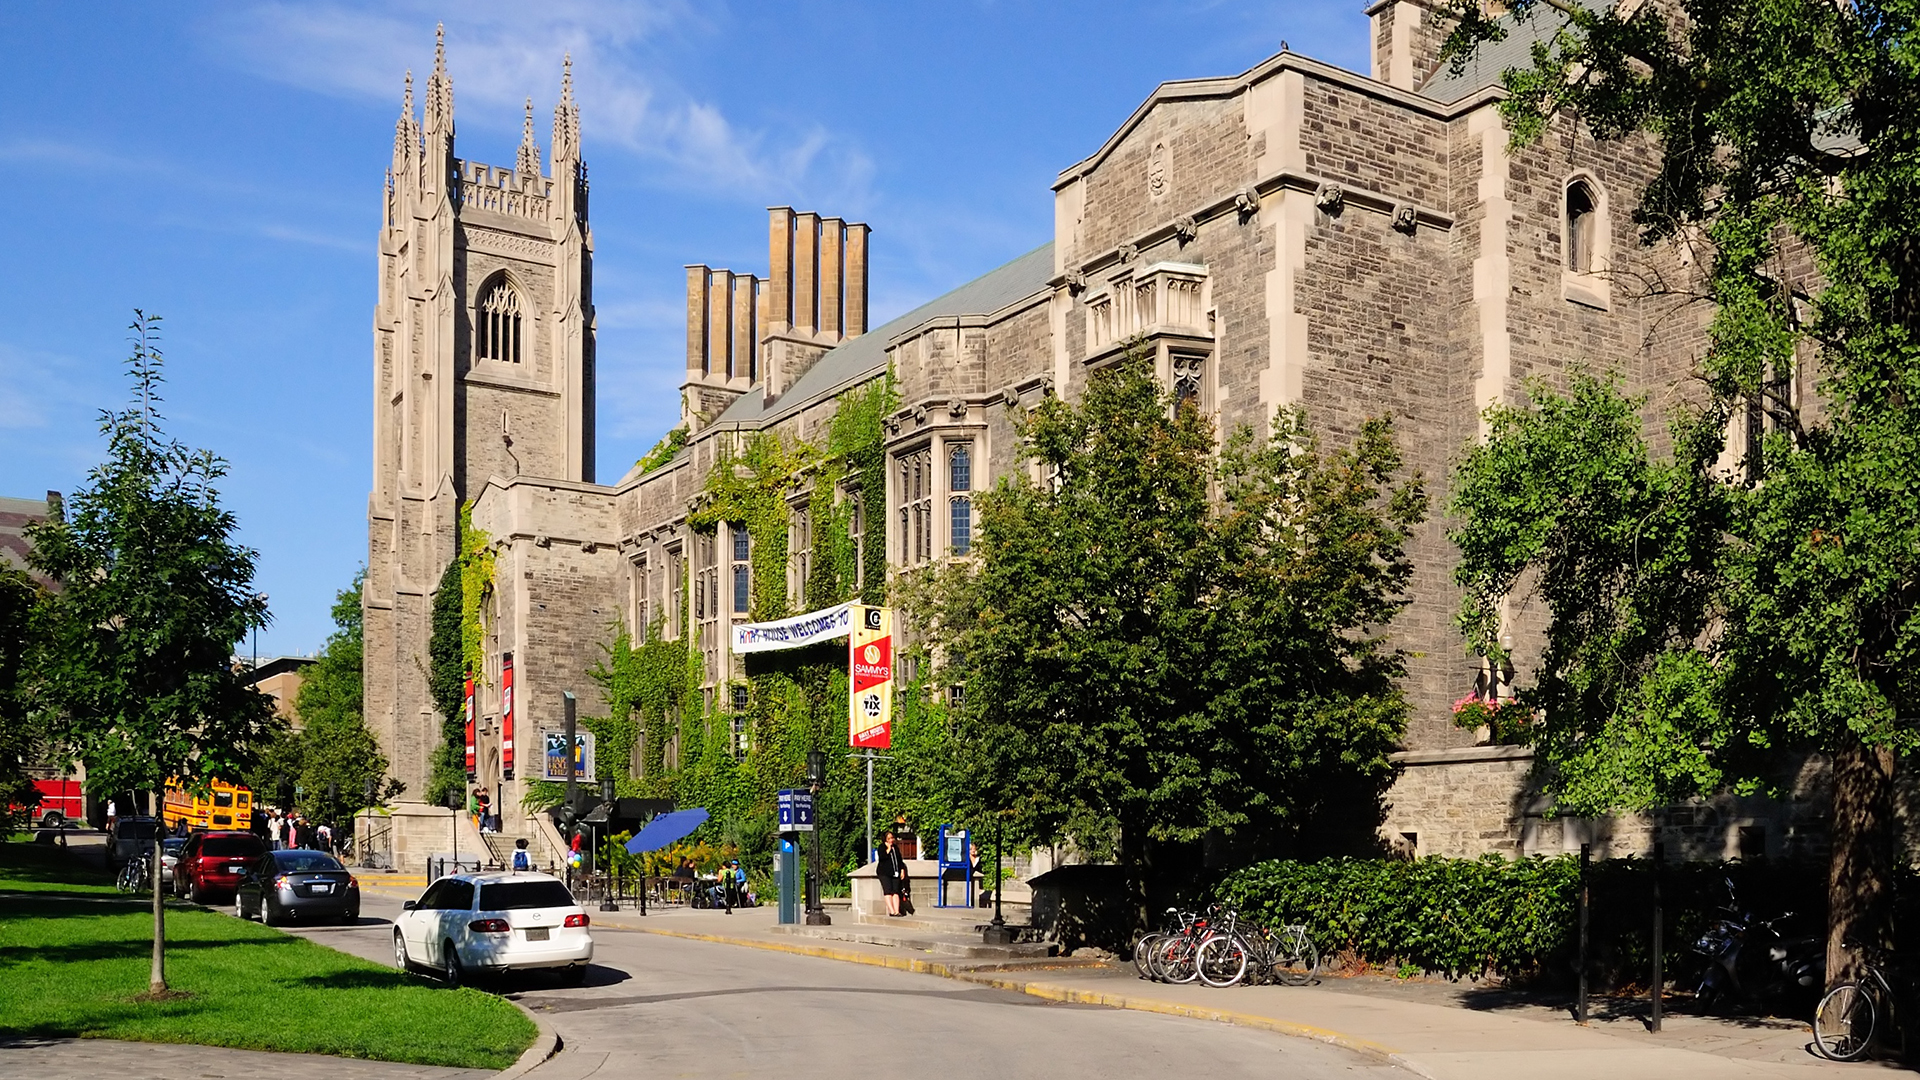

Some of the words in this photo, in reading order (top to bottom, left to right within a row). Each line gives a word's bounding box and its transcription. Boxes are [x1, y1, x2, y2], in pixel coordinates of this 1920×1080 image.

[763, 626, 789, 642] HOUSE
[788, 614, 836, 638] WELCOMES
[855, 664, 888, 675] SAMMY'S
